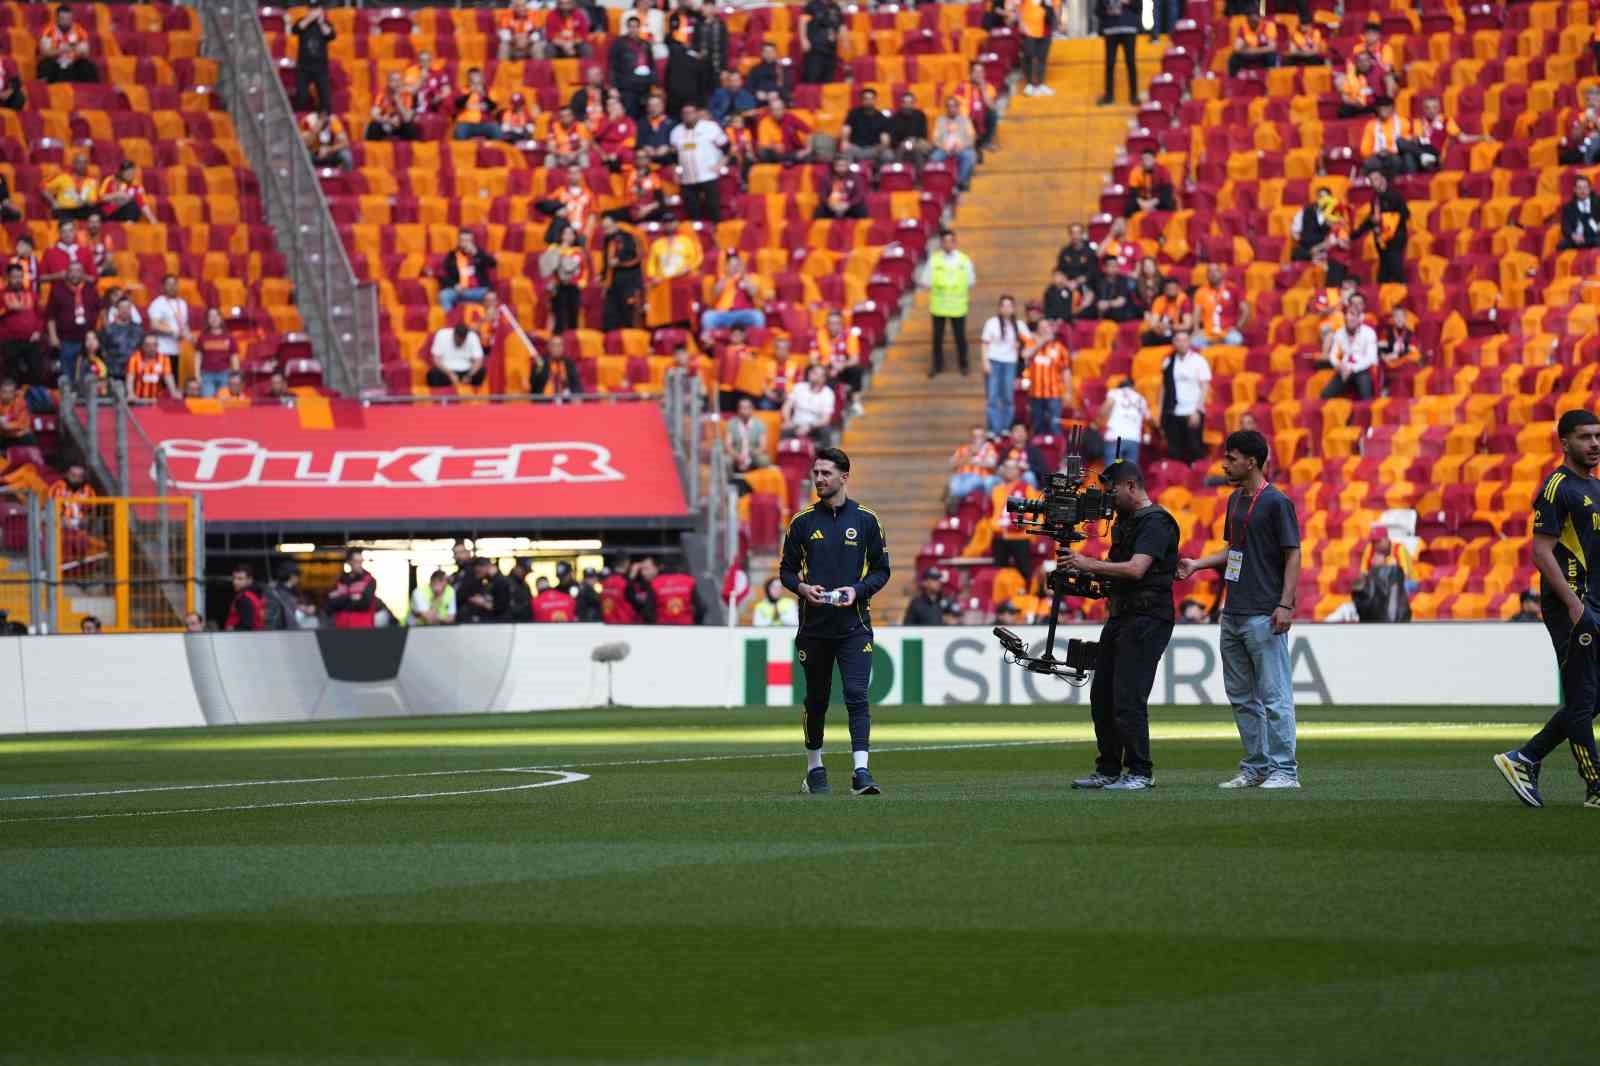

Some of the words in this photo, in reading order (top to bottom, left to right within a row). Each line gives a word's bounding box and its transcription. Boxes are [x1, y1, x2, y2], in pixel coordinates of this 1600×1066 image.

[150, 438, 625, 490] ÜLKER
[744, 638, 923, 705] HDI
[944, 637, 1333, 705] SIGRA
